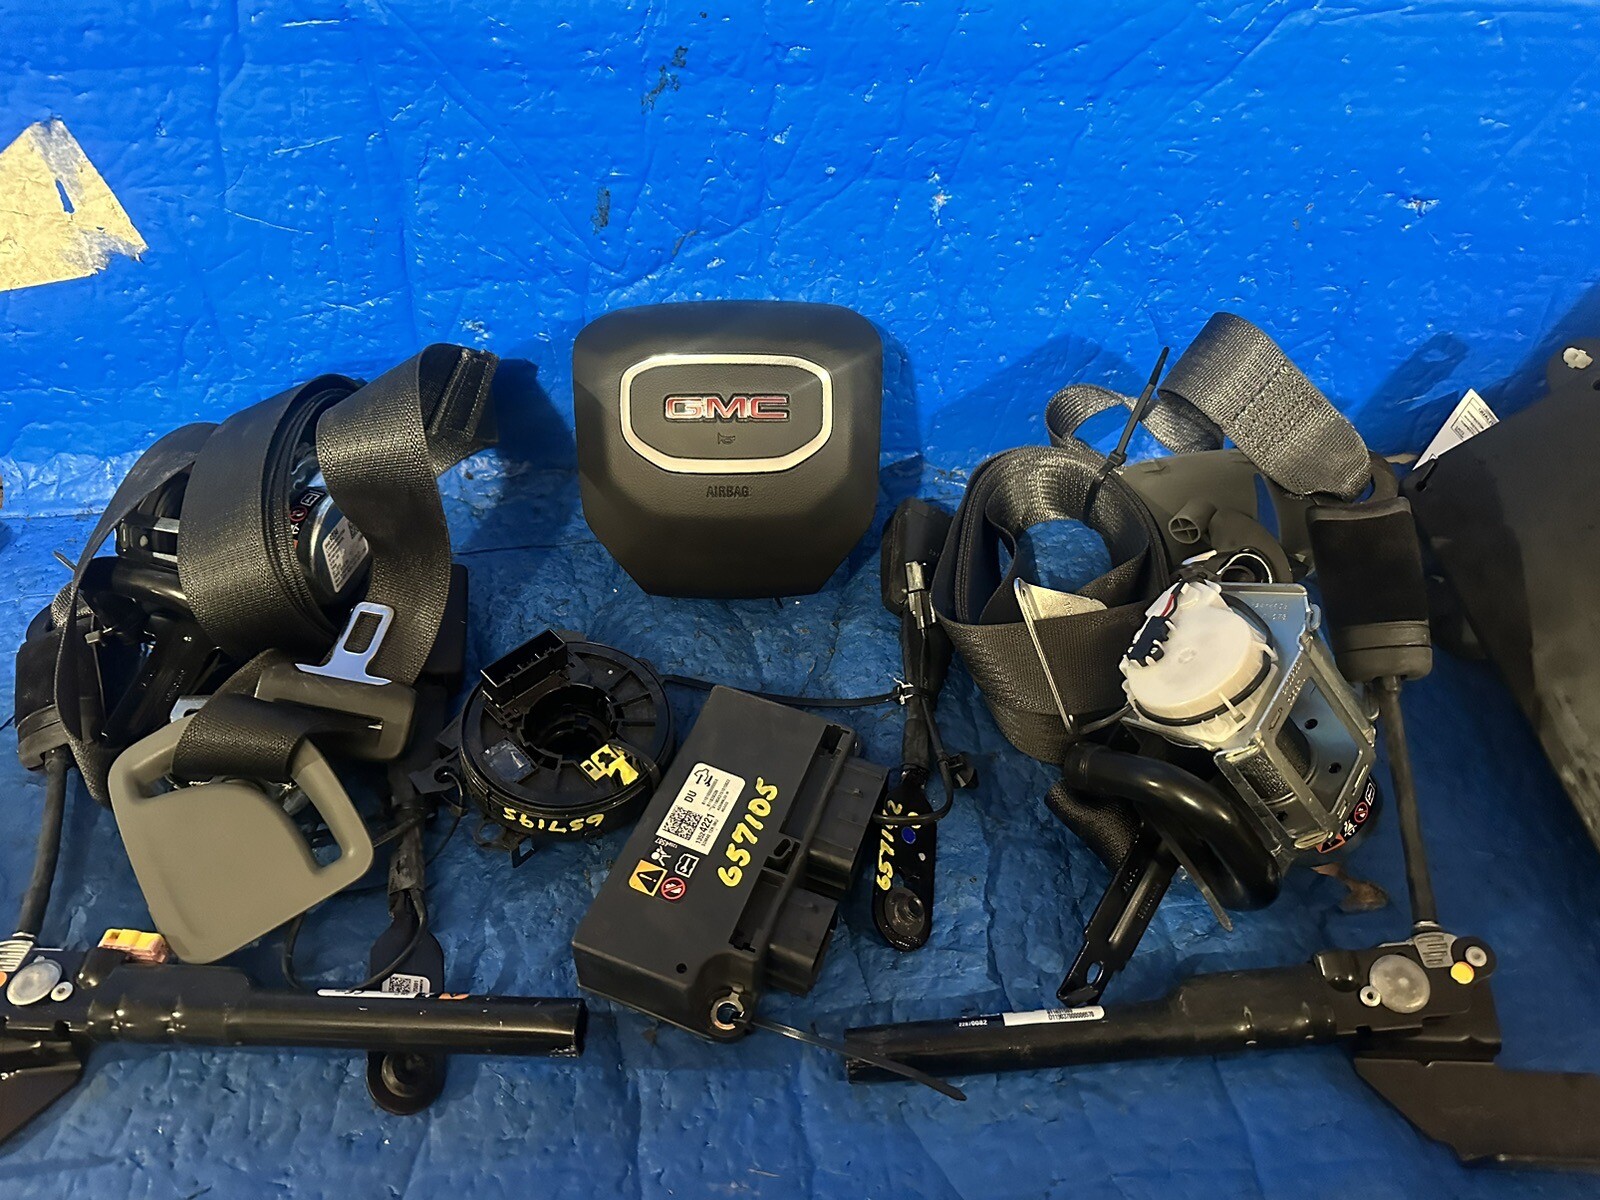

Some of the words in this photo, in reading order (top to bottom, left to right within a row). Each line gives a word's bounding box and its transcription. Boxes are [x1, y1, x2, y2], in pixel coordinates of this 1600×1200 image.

[664, 394, 789, 420] GMC
[706, 486, 750, 498] AIRBAG
[684, 789, 697, 803] DU
[503, 807, 604, 833] 657195
[717, 776, 778, 887] 657105
